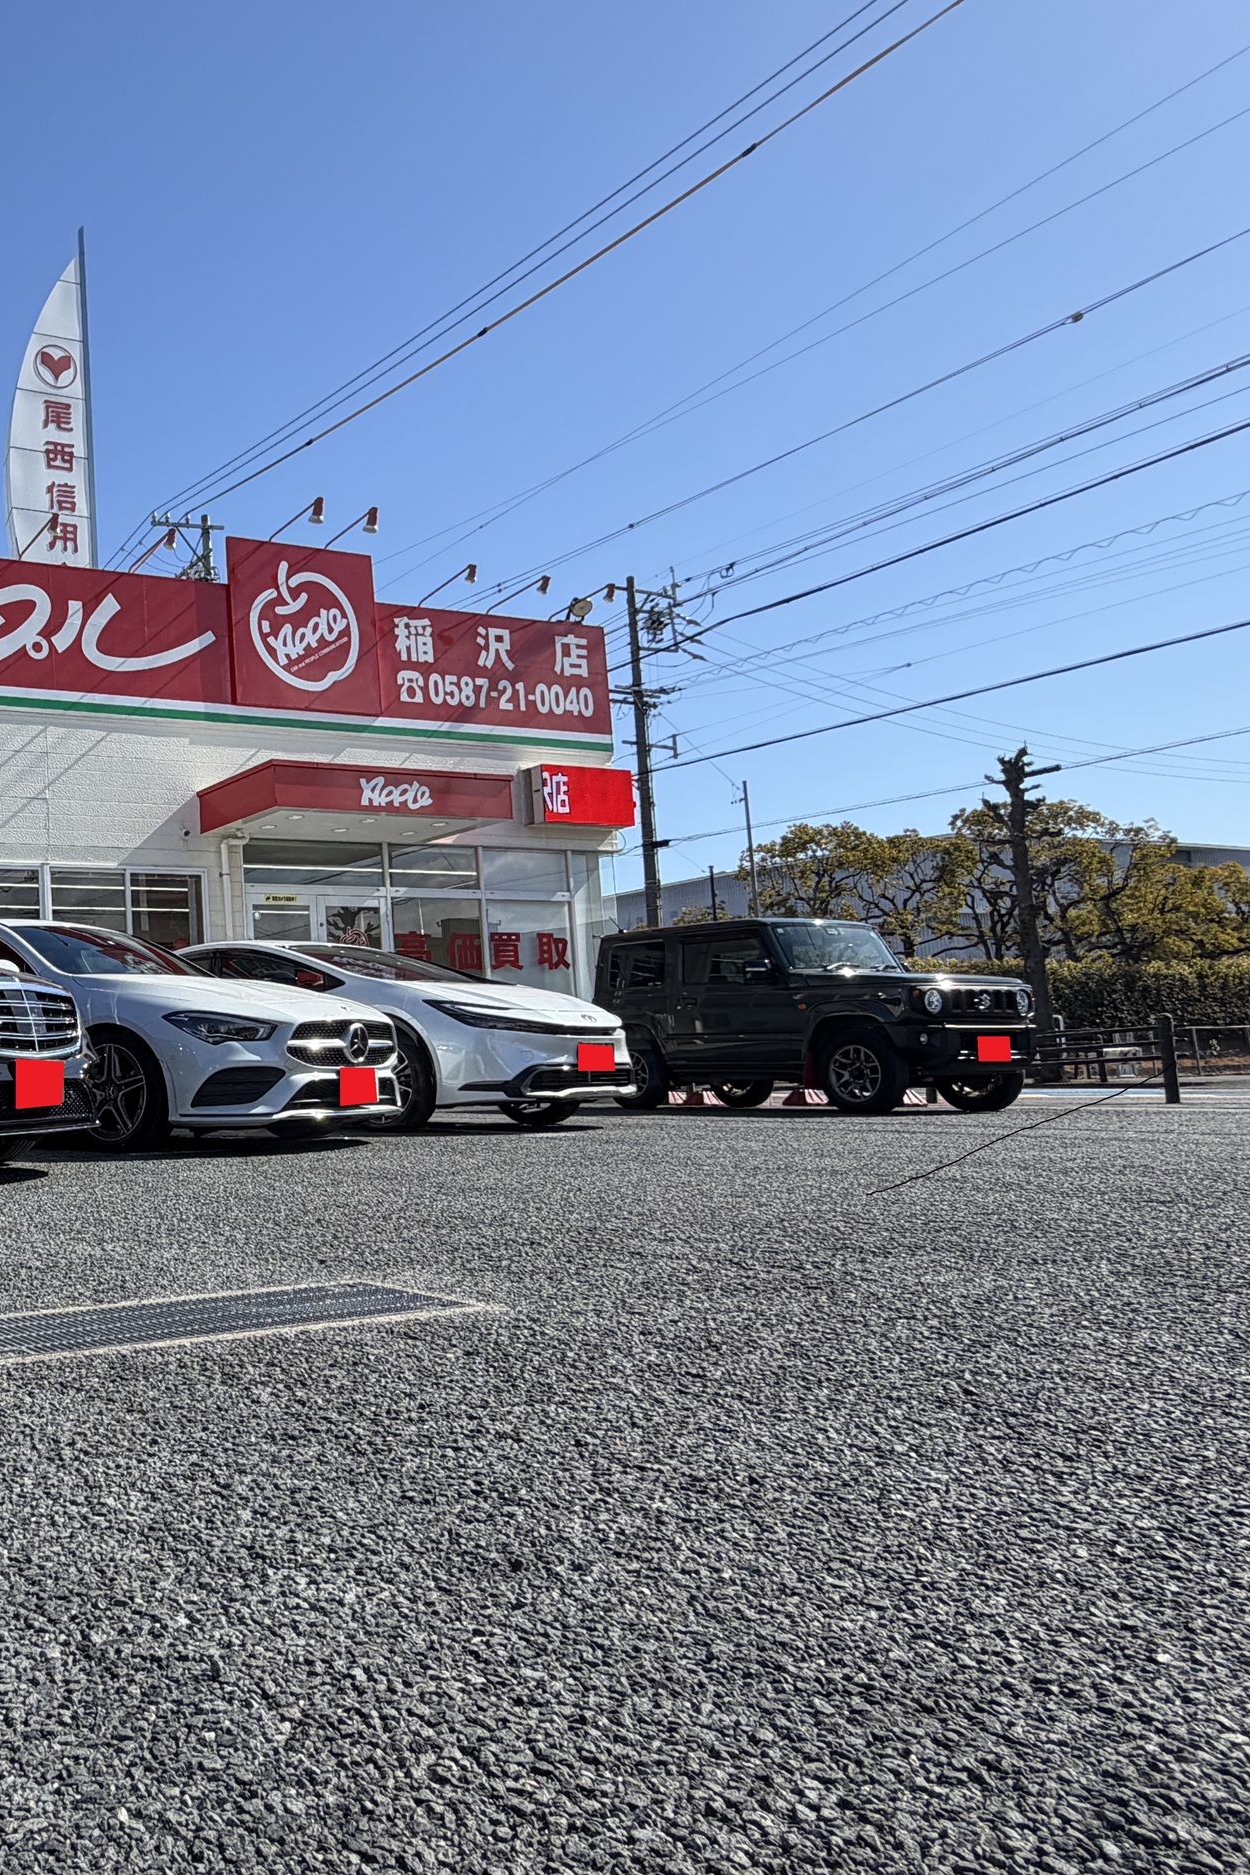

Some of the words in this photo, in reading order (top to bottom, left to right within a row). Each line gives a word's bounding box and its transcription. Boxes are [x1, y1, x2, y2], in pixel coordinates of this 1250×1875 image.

[42, 399, 79, 567] 尾西信用
[263, 608, 348, 667] Apple
[393, 616, 589, 678] 稲沢店
[428, 672, 594, 718] 0587-21-0040
[359, 776, 434, 810] Apple
